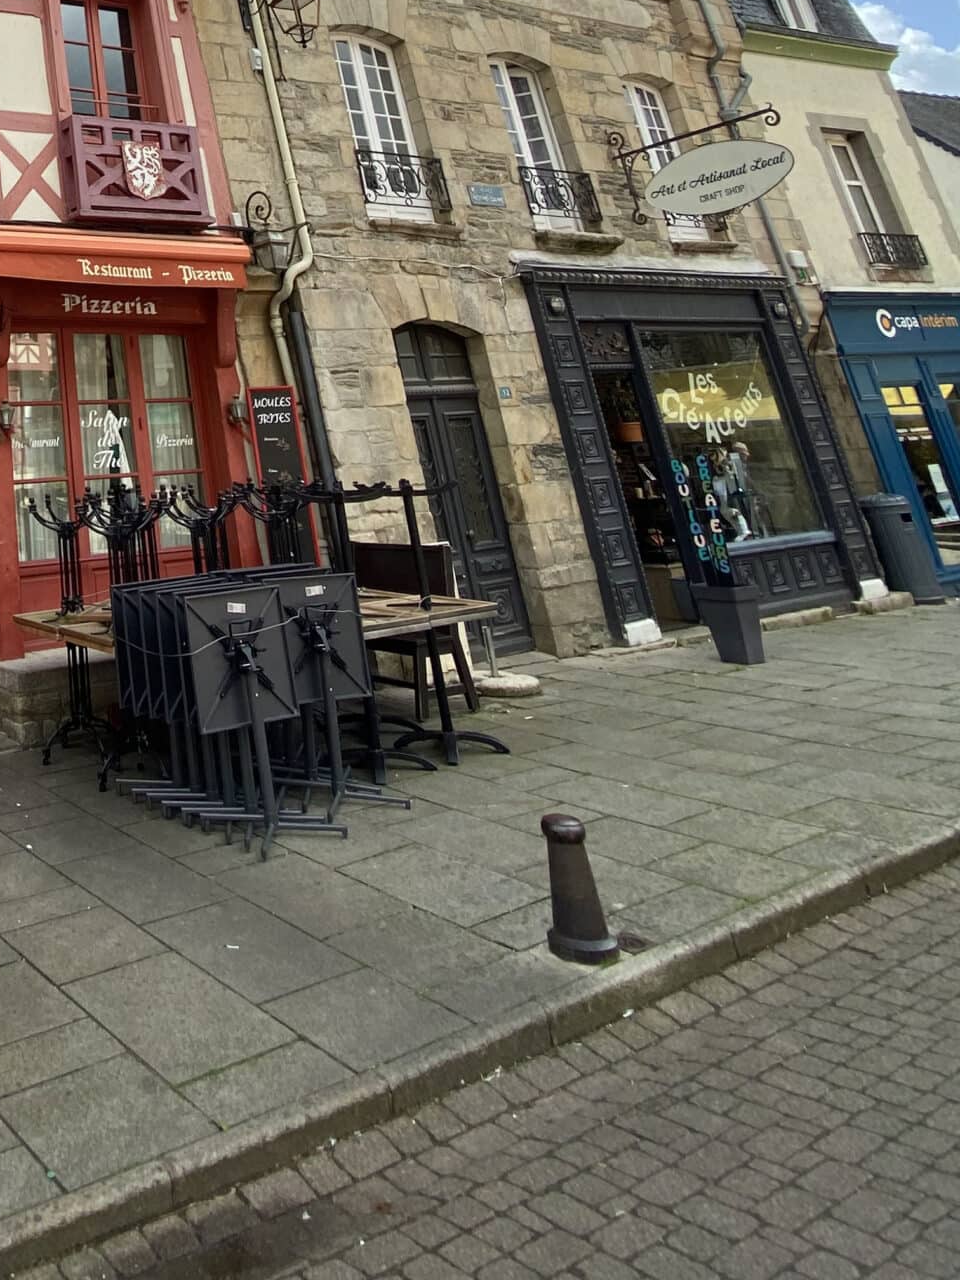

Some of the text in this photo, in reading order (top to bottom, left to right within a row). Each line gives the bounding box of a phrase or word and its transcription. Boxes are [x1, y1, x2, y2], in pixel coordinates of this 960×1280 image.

[650, 183, 675, 199] Art
[750, 151, 786, 172] Local
[699, 184, 745, 203] CRAFT SHOP
[76, 258, 153, 279] Restaurant
[178, 264, 235, 285] Pizzeria
[61, 293, 158, 316] Pizzeria
[687, 372, 718, 405] Les
[155, 433, 194, 449] Pizzeria
[671, 459, 711, 561] BOUTIQUE
[696, 454, 731, 574] CREATEURS
